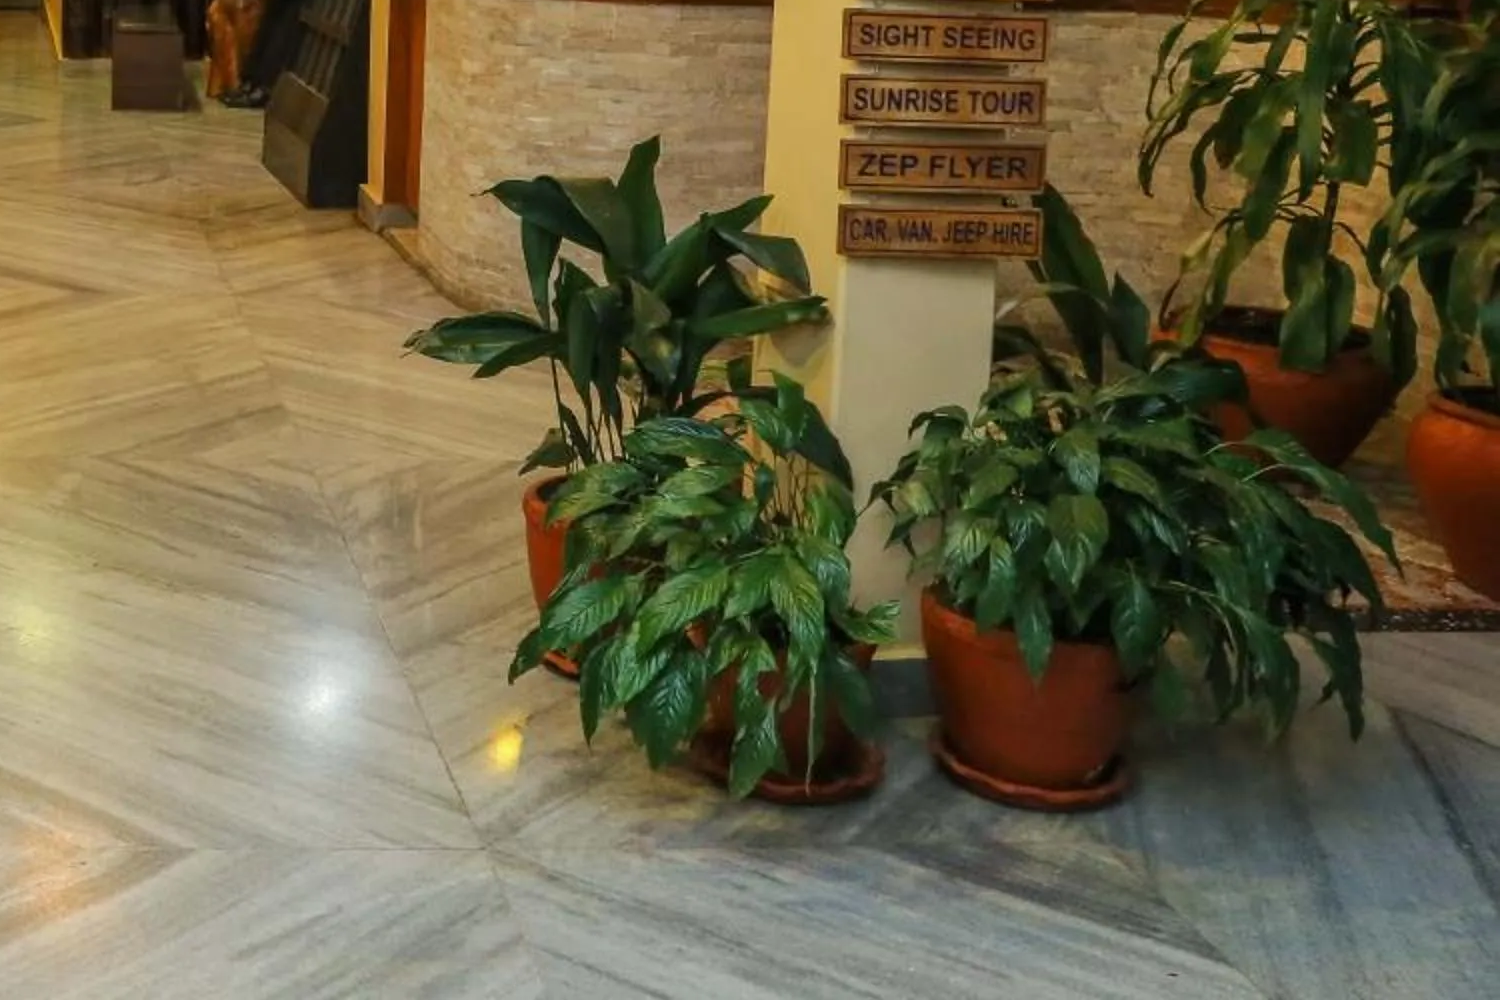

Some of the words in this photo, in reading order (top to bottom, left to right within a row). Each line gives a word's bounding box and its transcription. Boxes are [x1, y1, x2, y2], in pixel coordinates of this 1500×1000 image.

[859, 24, 934, 47] SIGHT
[943, 26, 1036, 51] SEEING
[854, 88, 959, 113] SUNRISE
[968, 90, 1035, 116] TOUR
[858, 153, 919, 177] ZEP
[929, 155, 1028, 179] FLYER
[945, 221, 987, 244] JEEP
[993, 223, 1035, 246] HIRE
